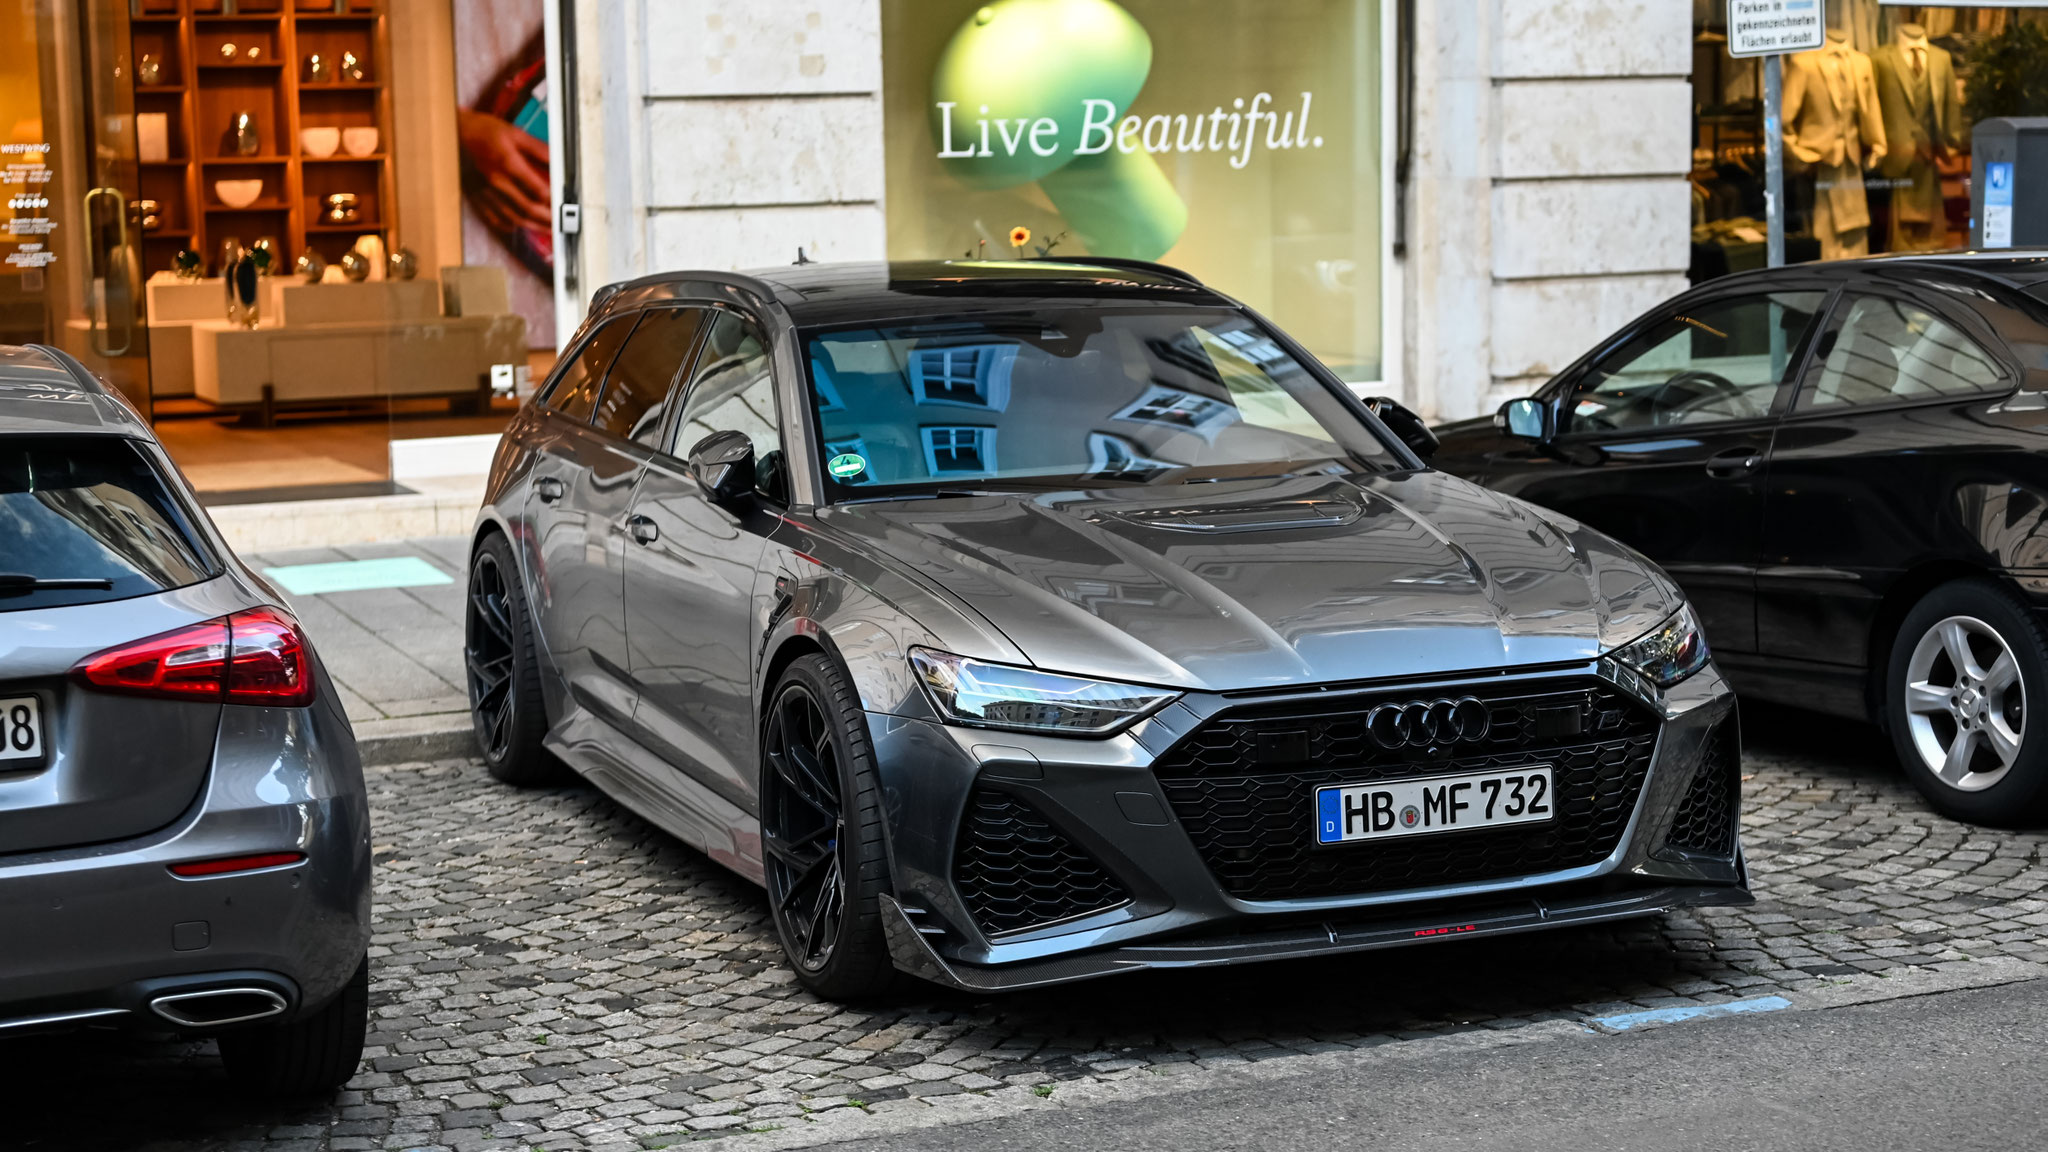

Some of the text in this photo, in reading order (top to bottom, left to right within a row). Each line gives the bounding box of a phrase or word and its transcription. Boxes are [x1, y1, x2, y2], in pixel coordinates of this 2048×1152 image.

[1738, 2, 1782, 14] Parken in
[1737, 16, 1816, 34] gekennzeichneten
[1741, 32, 1812, 47] Flächen erlaubt
[935, 92, 1324, 170] Live Beautiful.
[1, 143, 51, 154] WESTWING
[1344, 791, 1396, 835] HB
[1423, 782, 1472, 827] MF
[1480, 774, 1549, 820] 732
[1326, 821, 1335, 833] D
